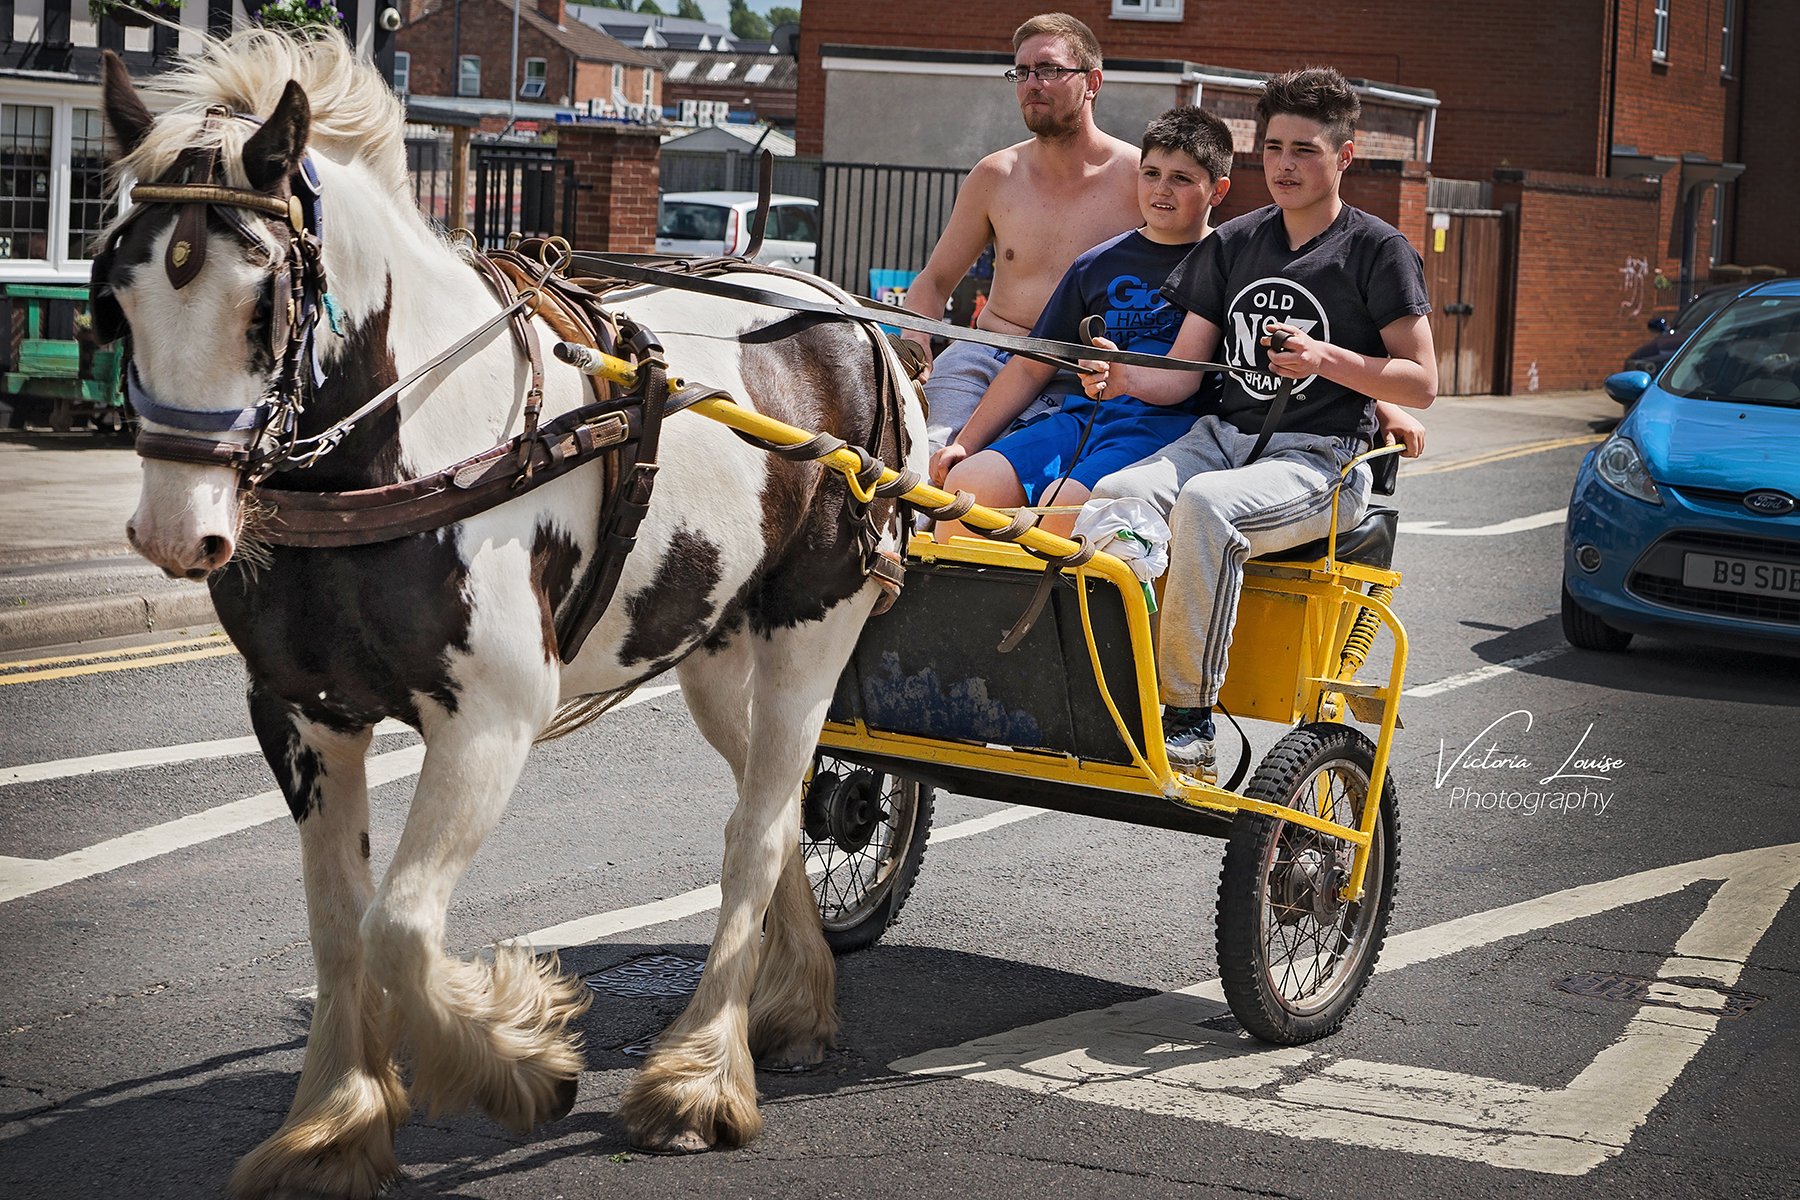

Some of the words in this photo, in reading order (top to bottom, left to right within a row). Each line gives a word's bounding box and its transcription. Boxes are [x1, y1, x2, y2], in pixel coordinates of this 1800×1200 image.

[1253, 290, 1294, 310] OLD
[1245, 372, 1298, 391] BRAN
[1754, 495, 1783, 509] Ford
[1712, 560, 1746, 586] B9
